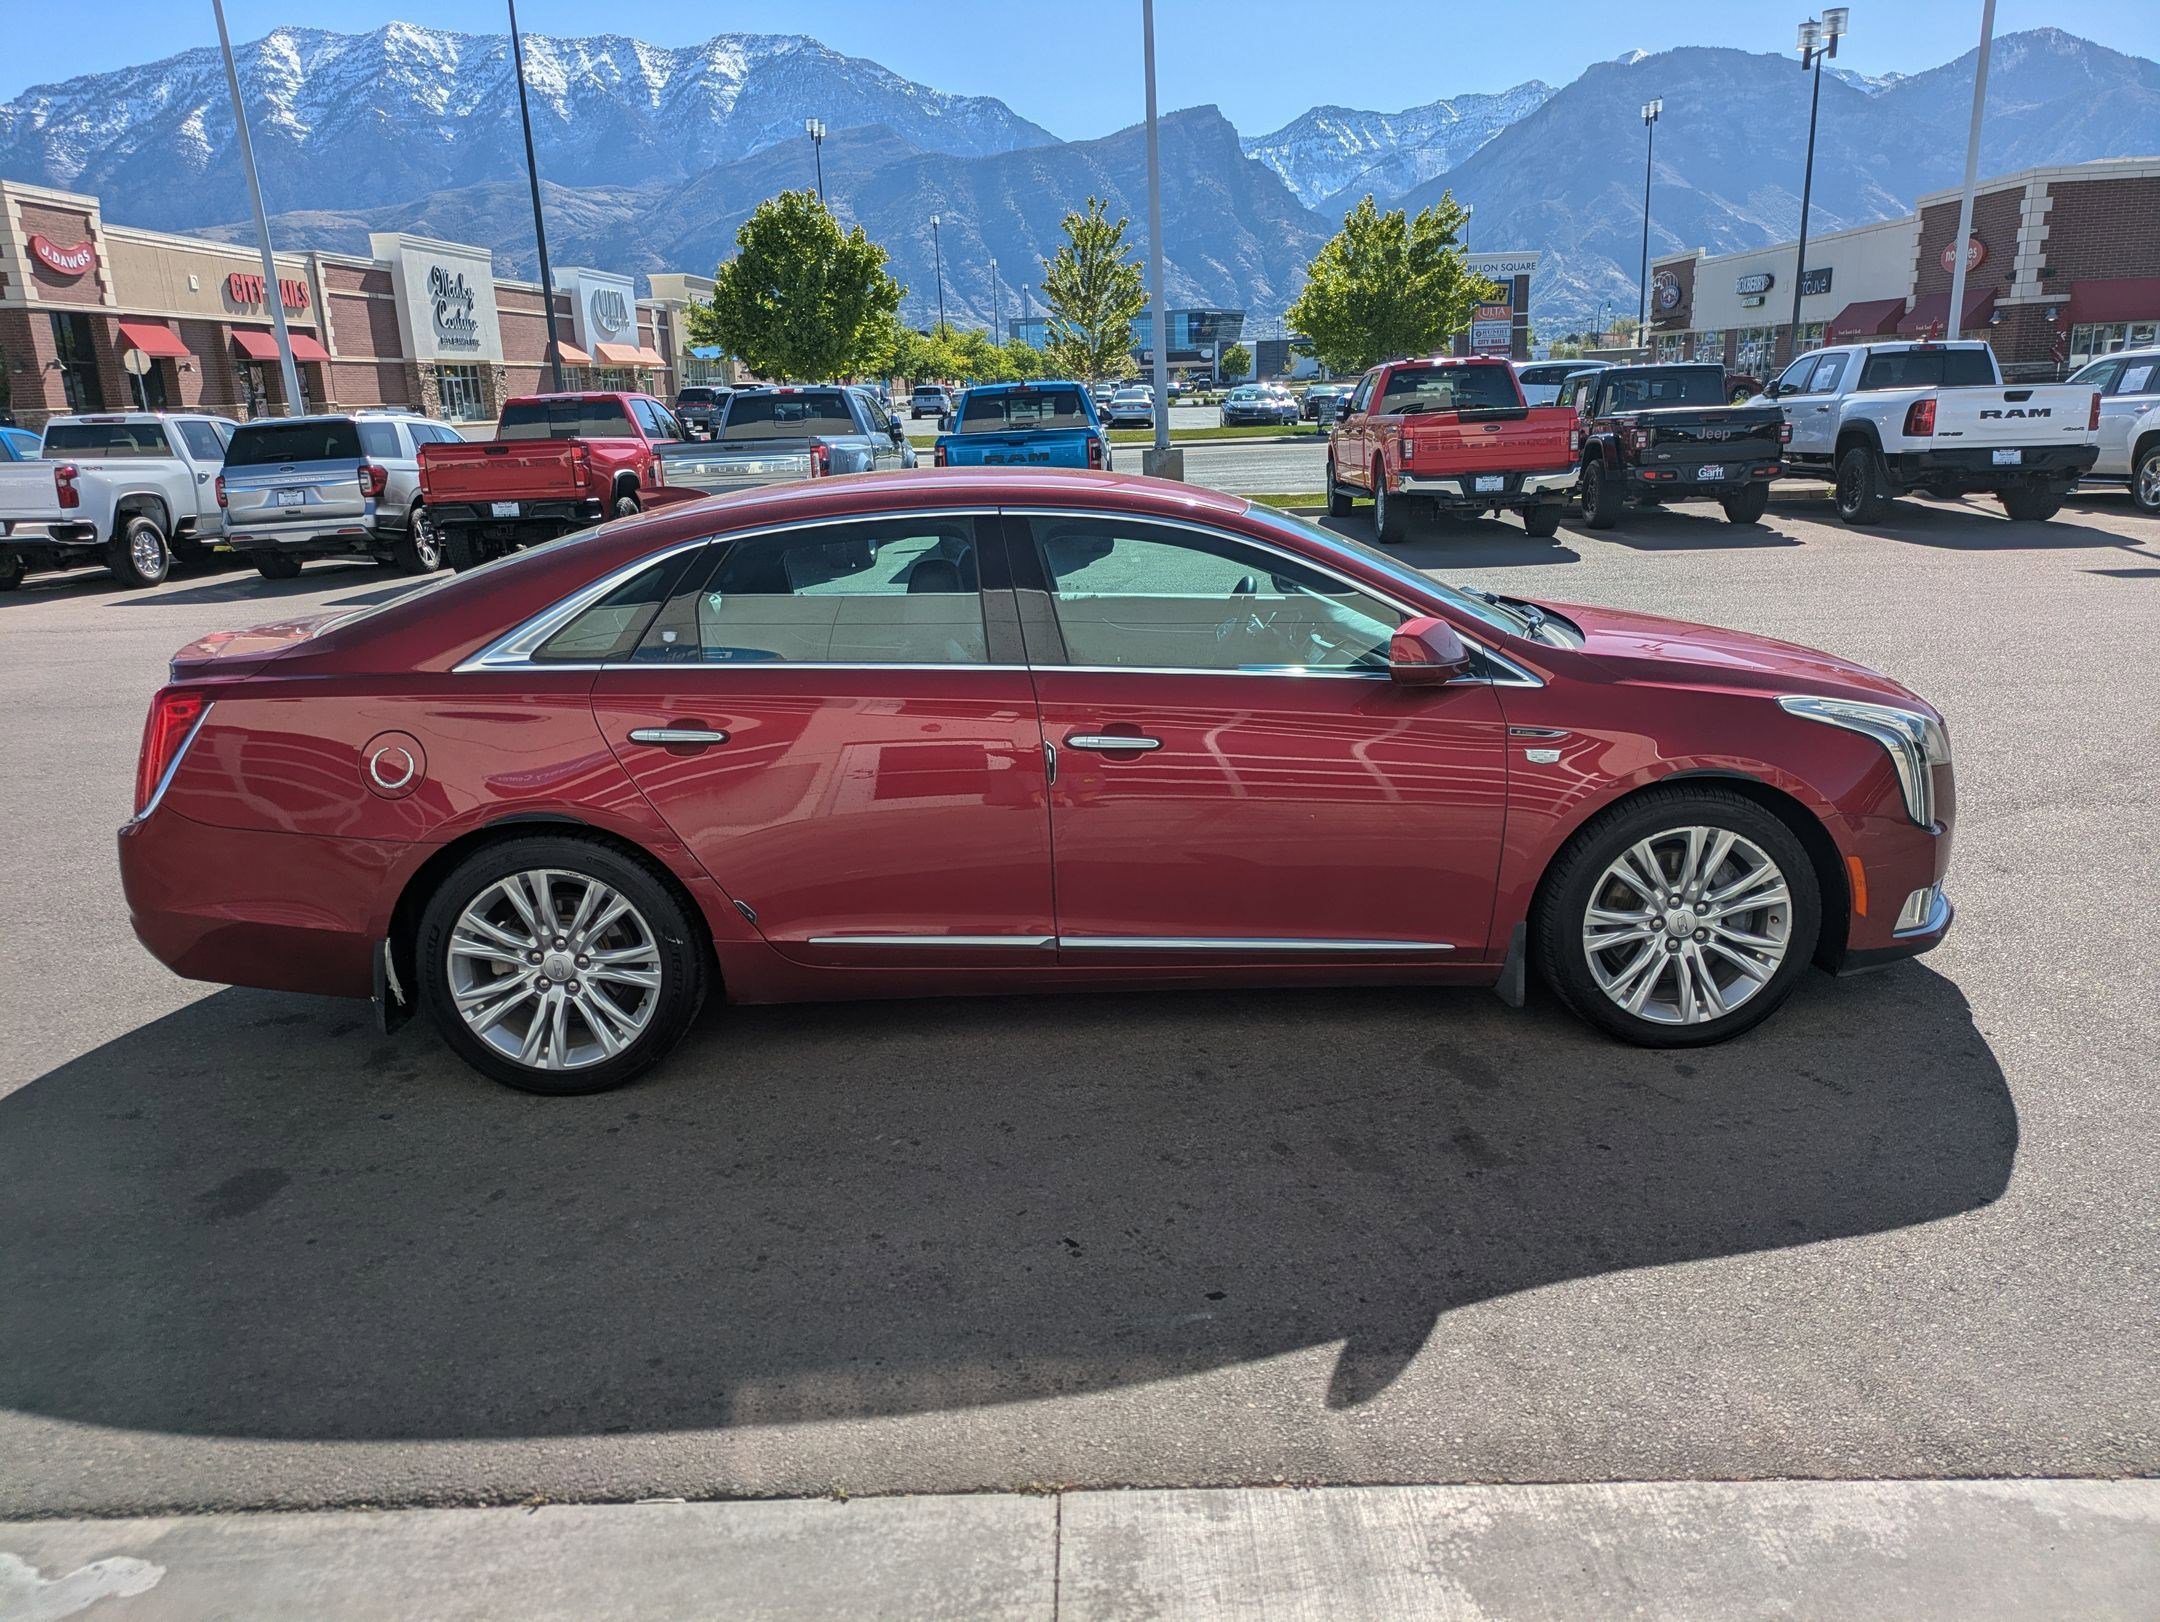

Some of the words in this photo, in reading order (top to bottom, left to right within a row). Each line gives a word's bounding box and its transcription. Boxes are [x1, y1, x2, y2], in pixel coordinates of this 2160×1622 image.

[1945, 248, 1977, 262] noes
[1500, 262, 1536, 272] SQUARE
[229, 273, 264, 304] CITY
[279, 279, 310, 309] AILS
[430, 265, 475, 312] Minky
[436, 299, 479, 331] Couture
[1482, 305, 1506, 318] ULTA
[1979, 408, 2052, 420] RAM
[1696, 426, 1731, 441] Jeep
[984, 452, 1050, 465] RAM
[1698, 466, 1725, 478] Garff
